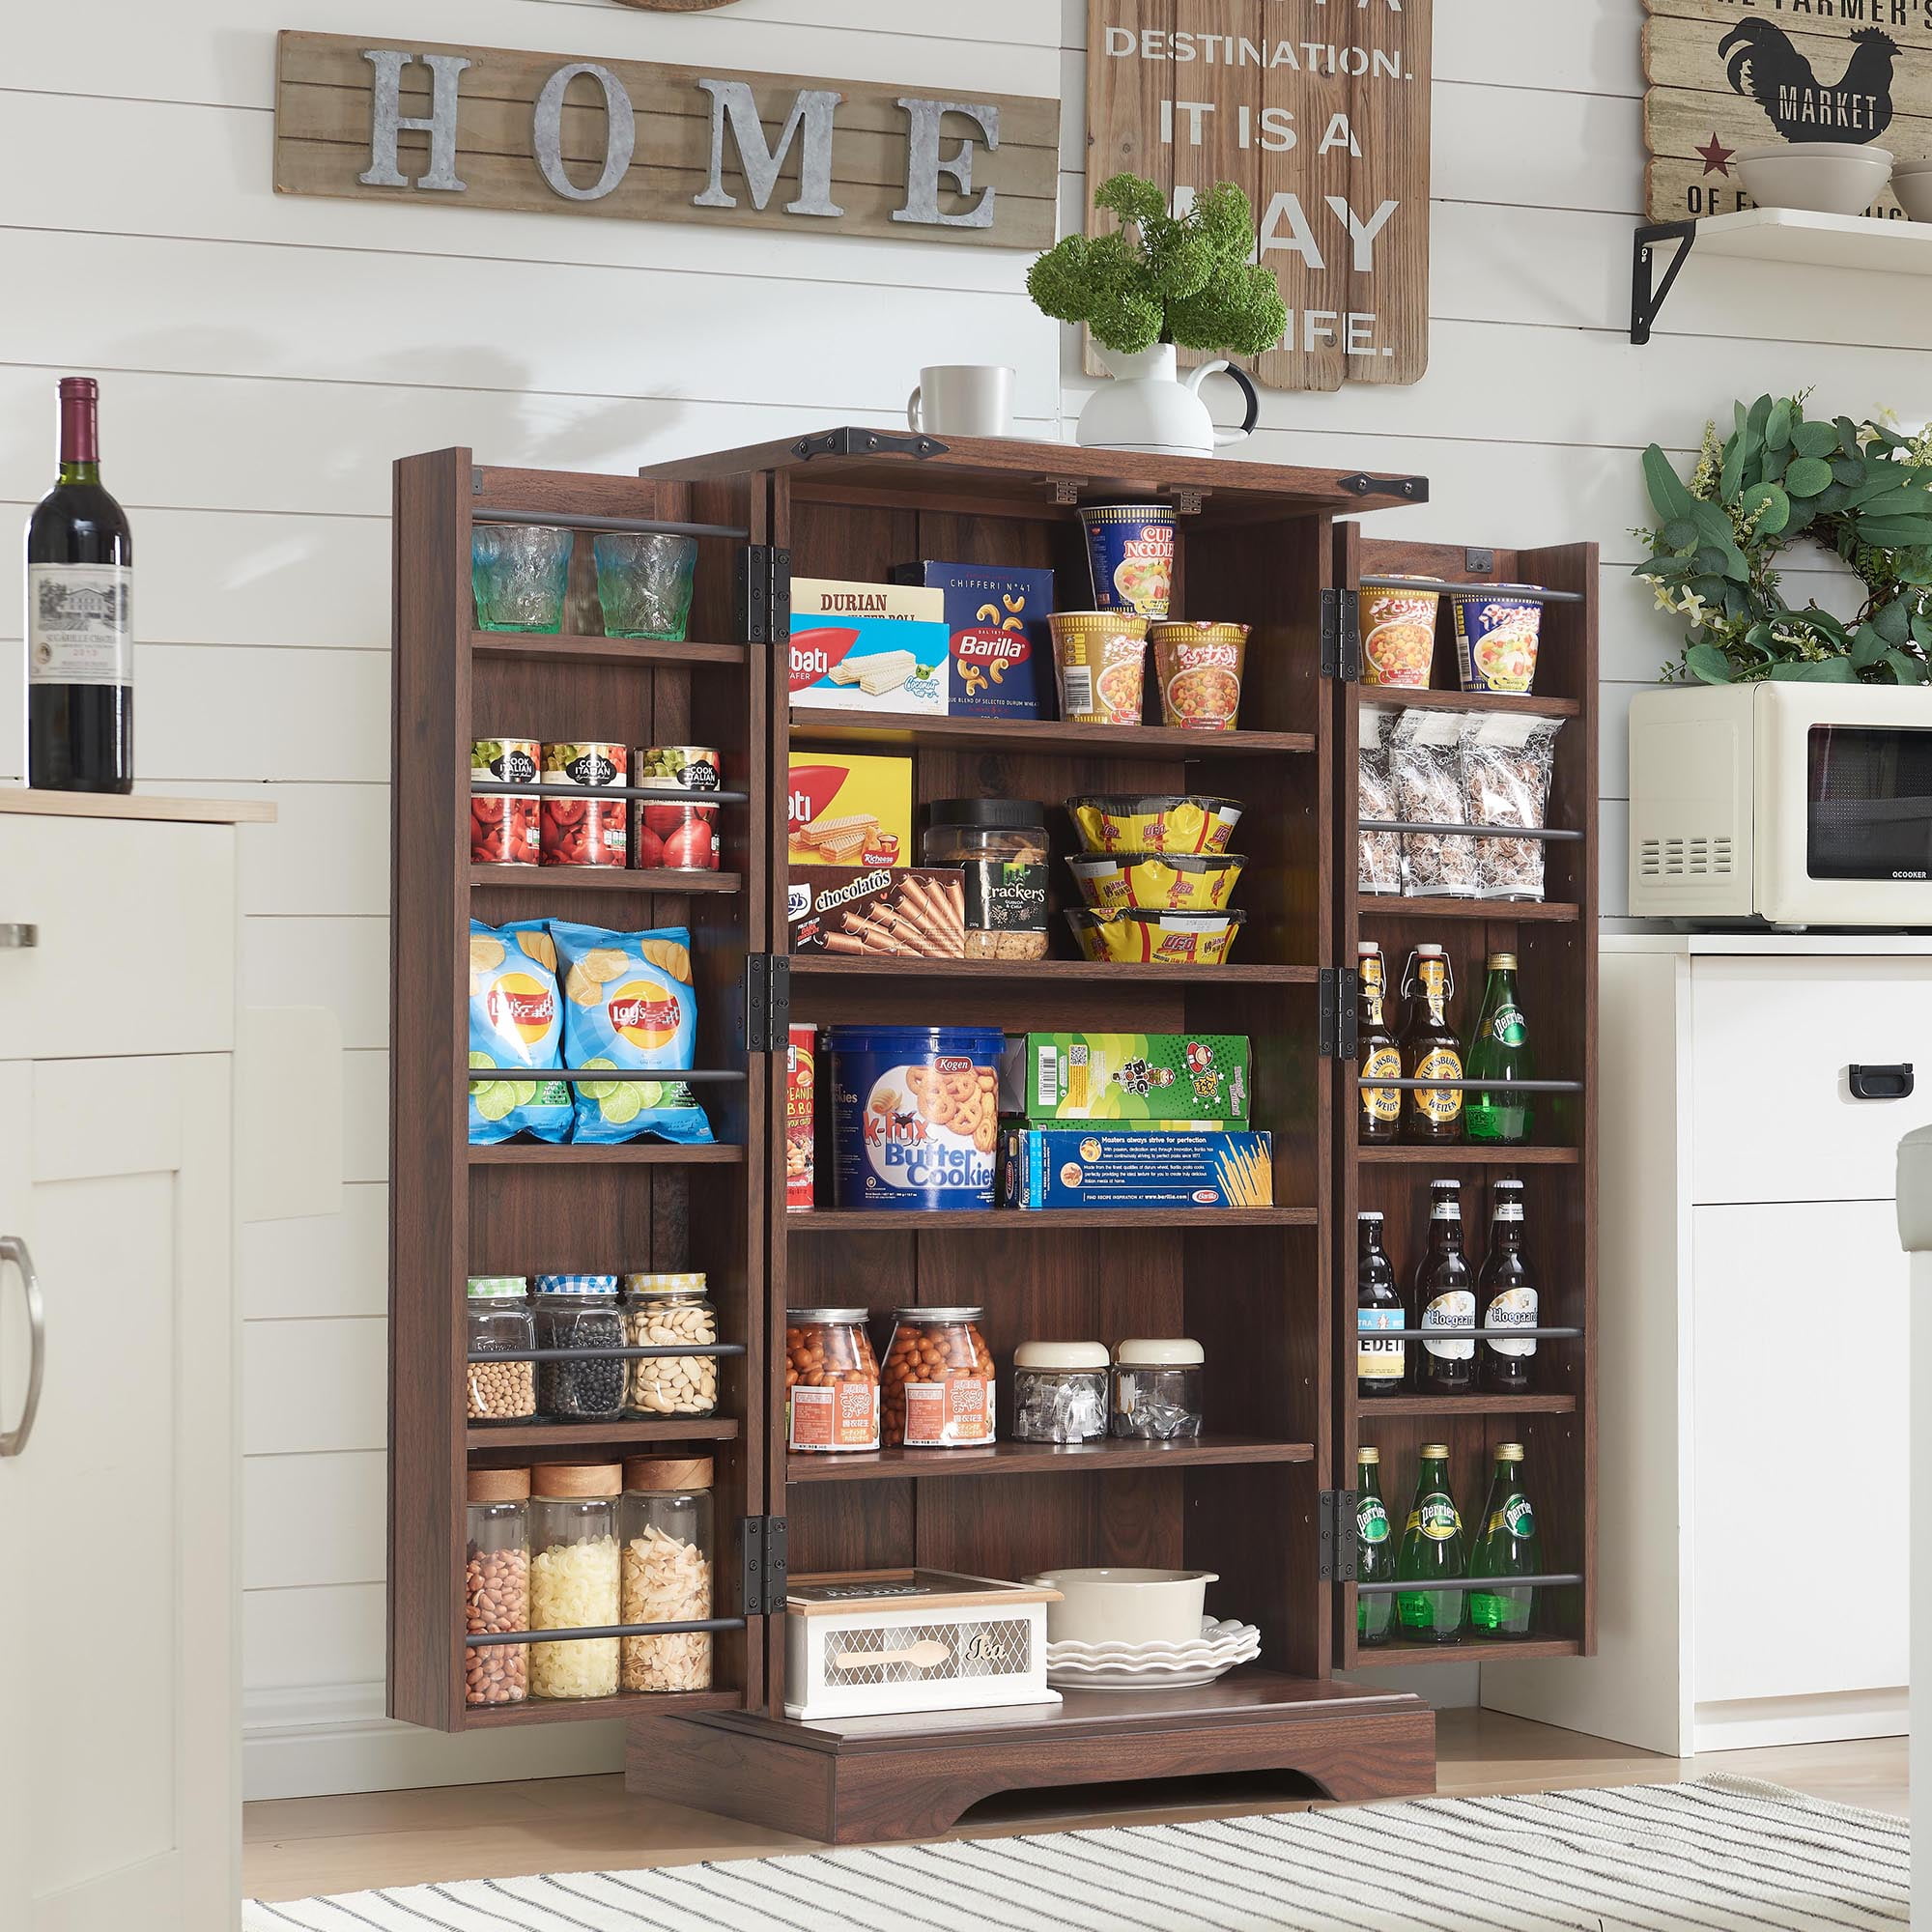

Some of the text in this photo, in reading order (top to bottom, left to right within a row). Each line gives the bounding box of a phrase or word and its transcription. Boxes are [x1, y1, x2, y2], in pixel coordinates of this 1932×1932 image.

[1105, 26, 1413, 80] DESTINATION.
[1779, 84, 1877, 130] MARKET
[1160, 99, 1362, 157] IT IS A
[355, 49, 1002, 229] HOME
[1688, 185, 1719, 215] OF
[1269, 308, 1393, 356] IFE.
[1142, 526, 1173, 541] CUP
[951, 579, 1000, 590] CHIFFERI
[820, 593, 888, 611] DURIAN
[958, 636, 1023, 658] Barilla
[788, 646, 828, 673] bati
[579, 758, 607, 769] COOK
[690, 766, 713, 775] COOK
[1891, 870, 1927, 879] OCOOKER
[1162, 934, 1197, 951] UFO
[613, 1004, 645, 1025] Lay's
[939, 1058, 968, 1072] Kogen
[1429, 1099, 1457, 1113] WEIZEN
[1101, 1136, 1125, 1145] Masters
[1127, 1136, 1147, 1145] always
[1149, 1136, 1165, 1145] strive
[1166, 1136, 1175, 1145] for
[885, 1144, 978, 1167] Butter
[906, 1161, 995, 1186] Cookies
[964, 1633, 1009, 1663] Tea
